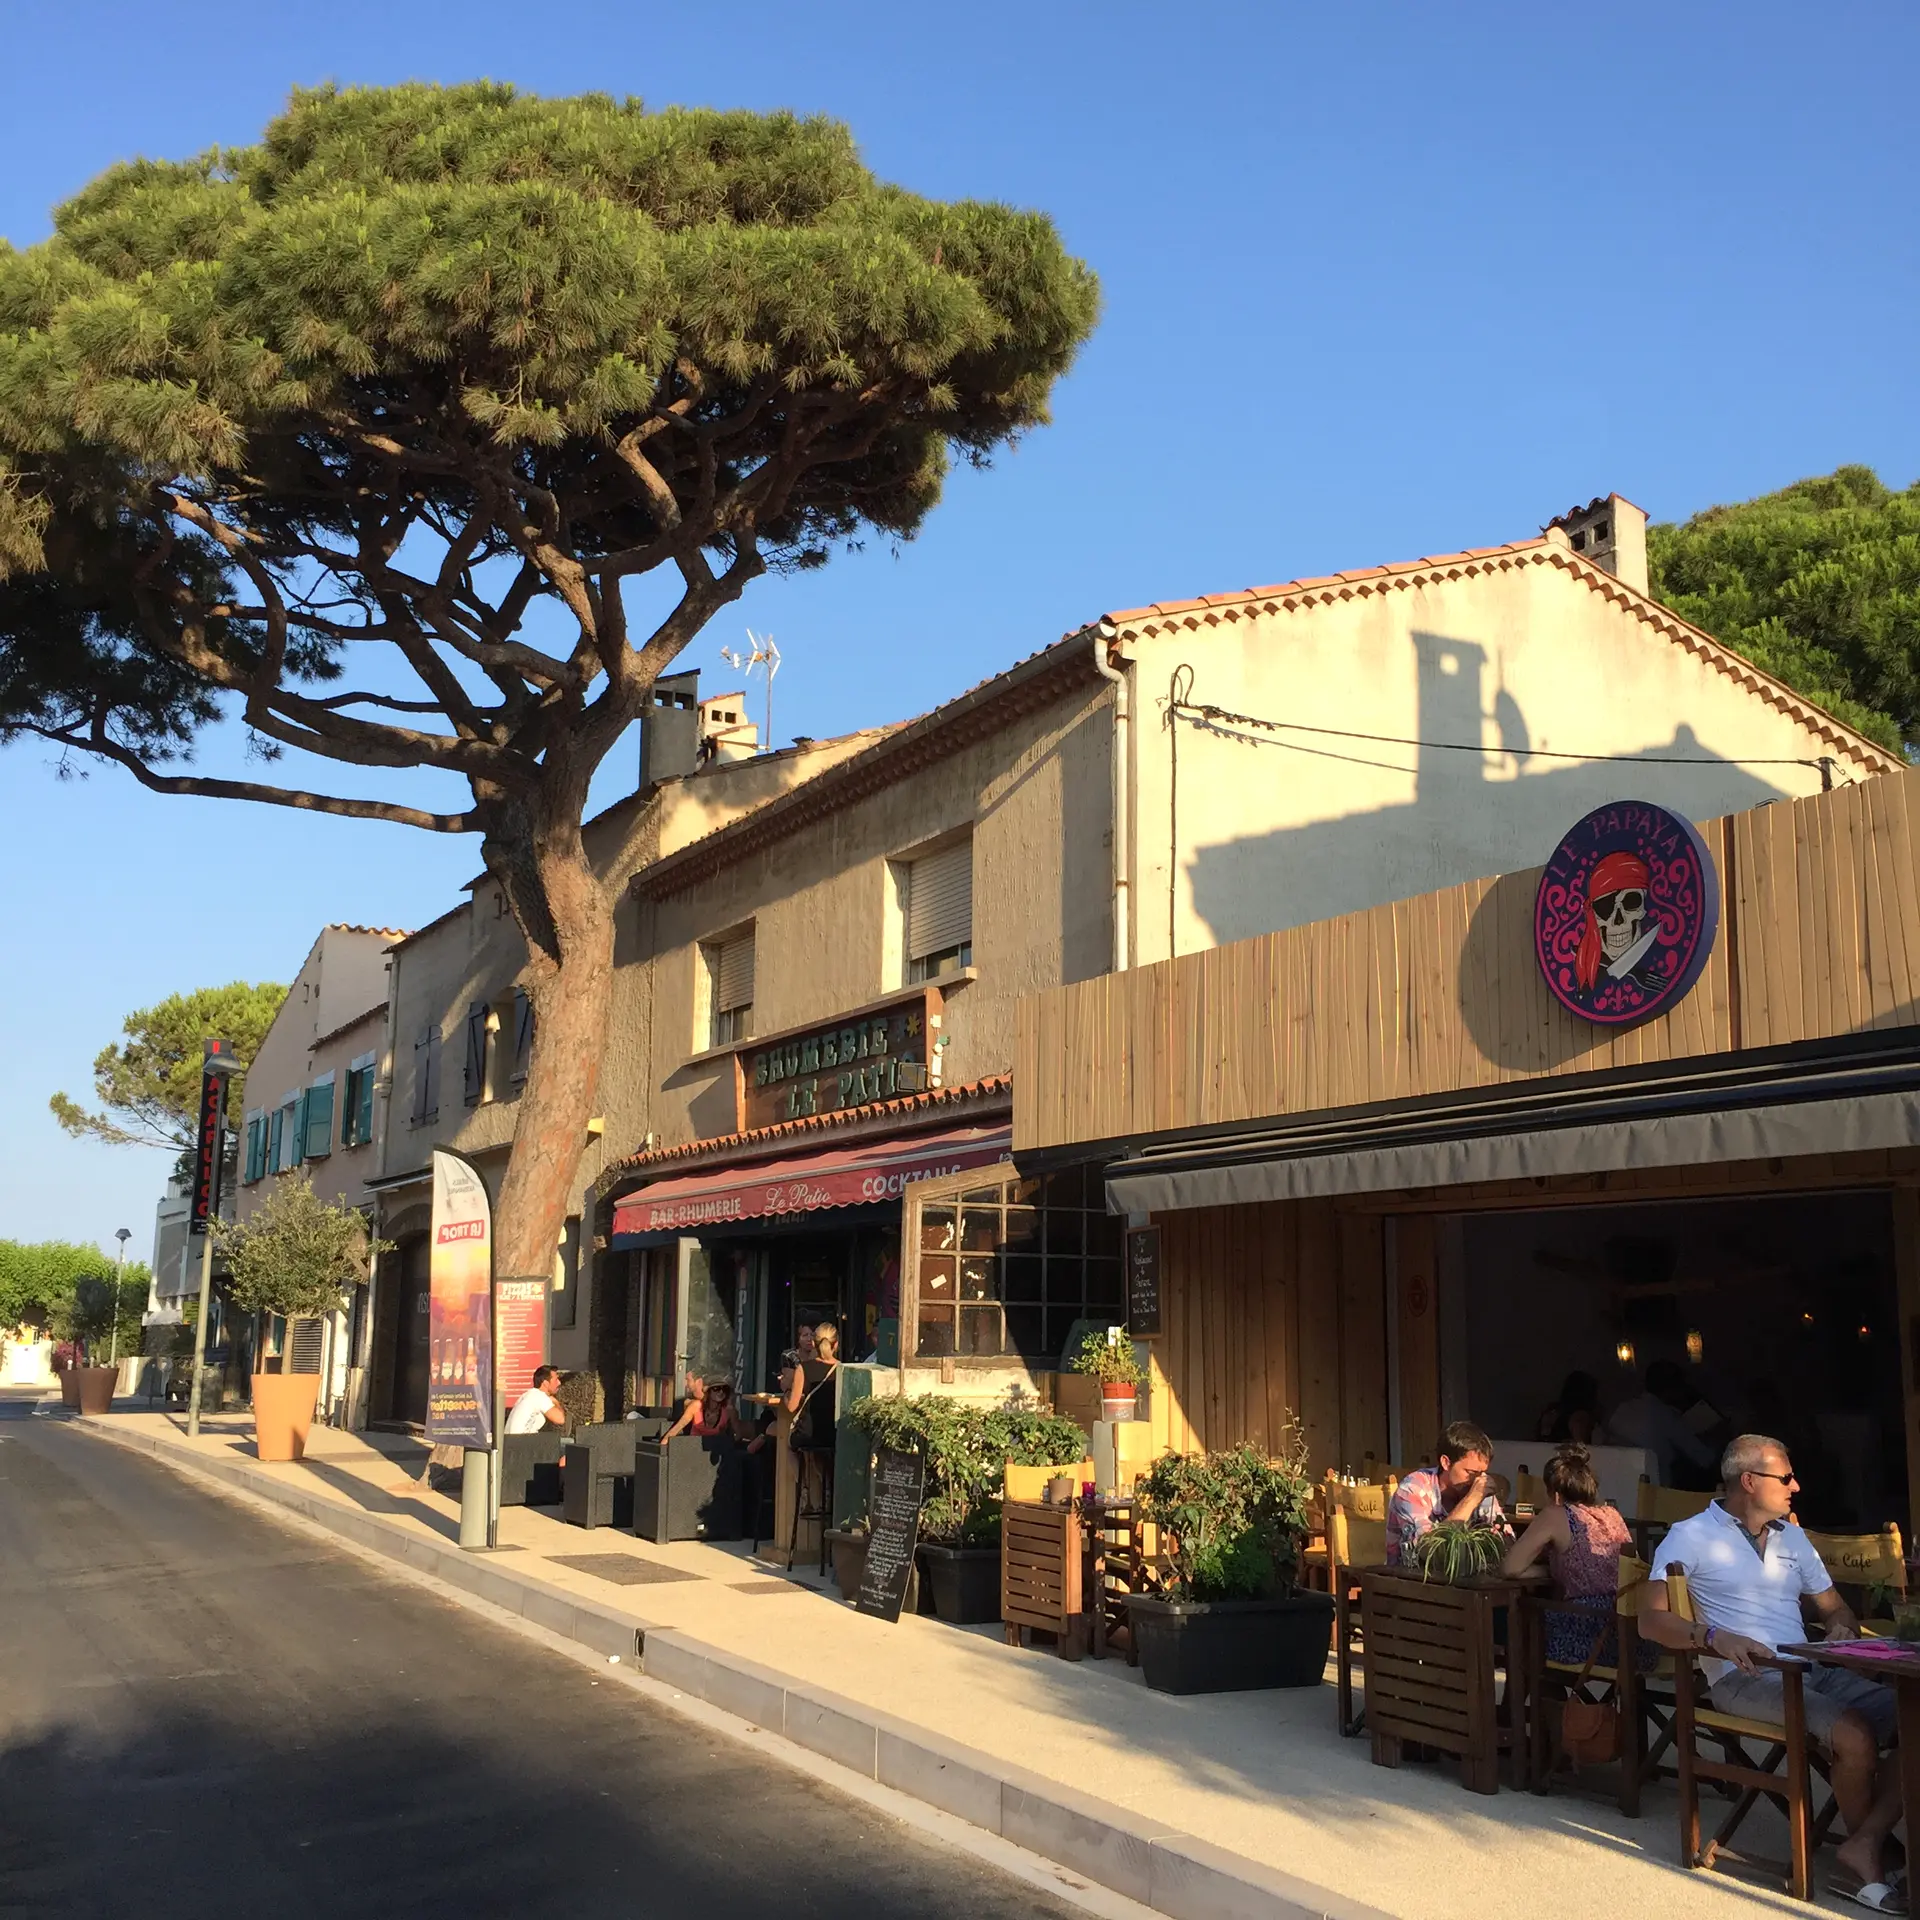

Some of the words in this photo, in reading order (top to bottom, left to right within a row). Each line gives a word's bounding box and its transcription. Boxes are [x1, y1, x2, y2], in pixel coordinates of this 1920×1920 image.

[1550, 838, 1580, 878] LE
[1585, 806, 1681, 857] PAPAYA
[786, 1078, 818, 1119] LE
[834, 1054, 905, 1109] PATI
[650, 1197, 741, 1226] BAR-RHUMERIE
[765, 1187, 787, 1211] Le
[788, 1183, 831, 1208] Patio
[1842, 1552, 1872, 1572] Café
